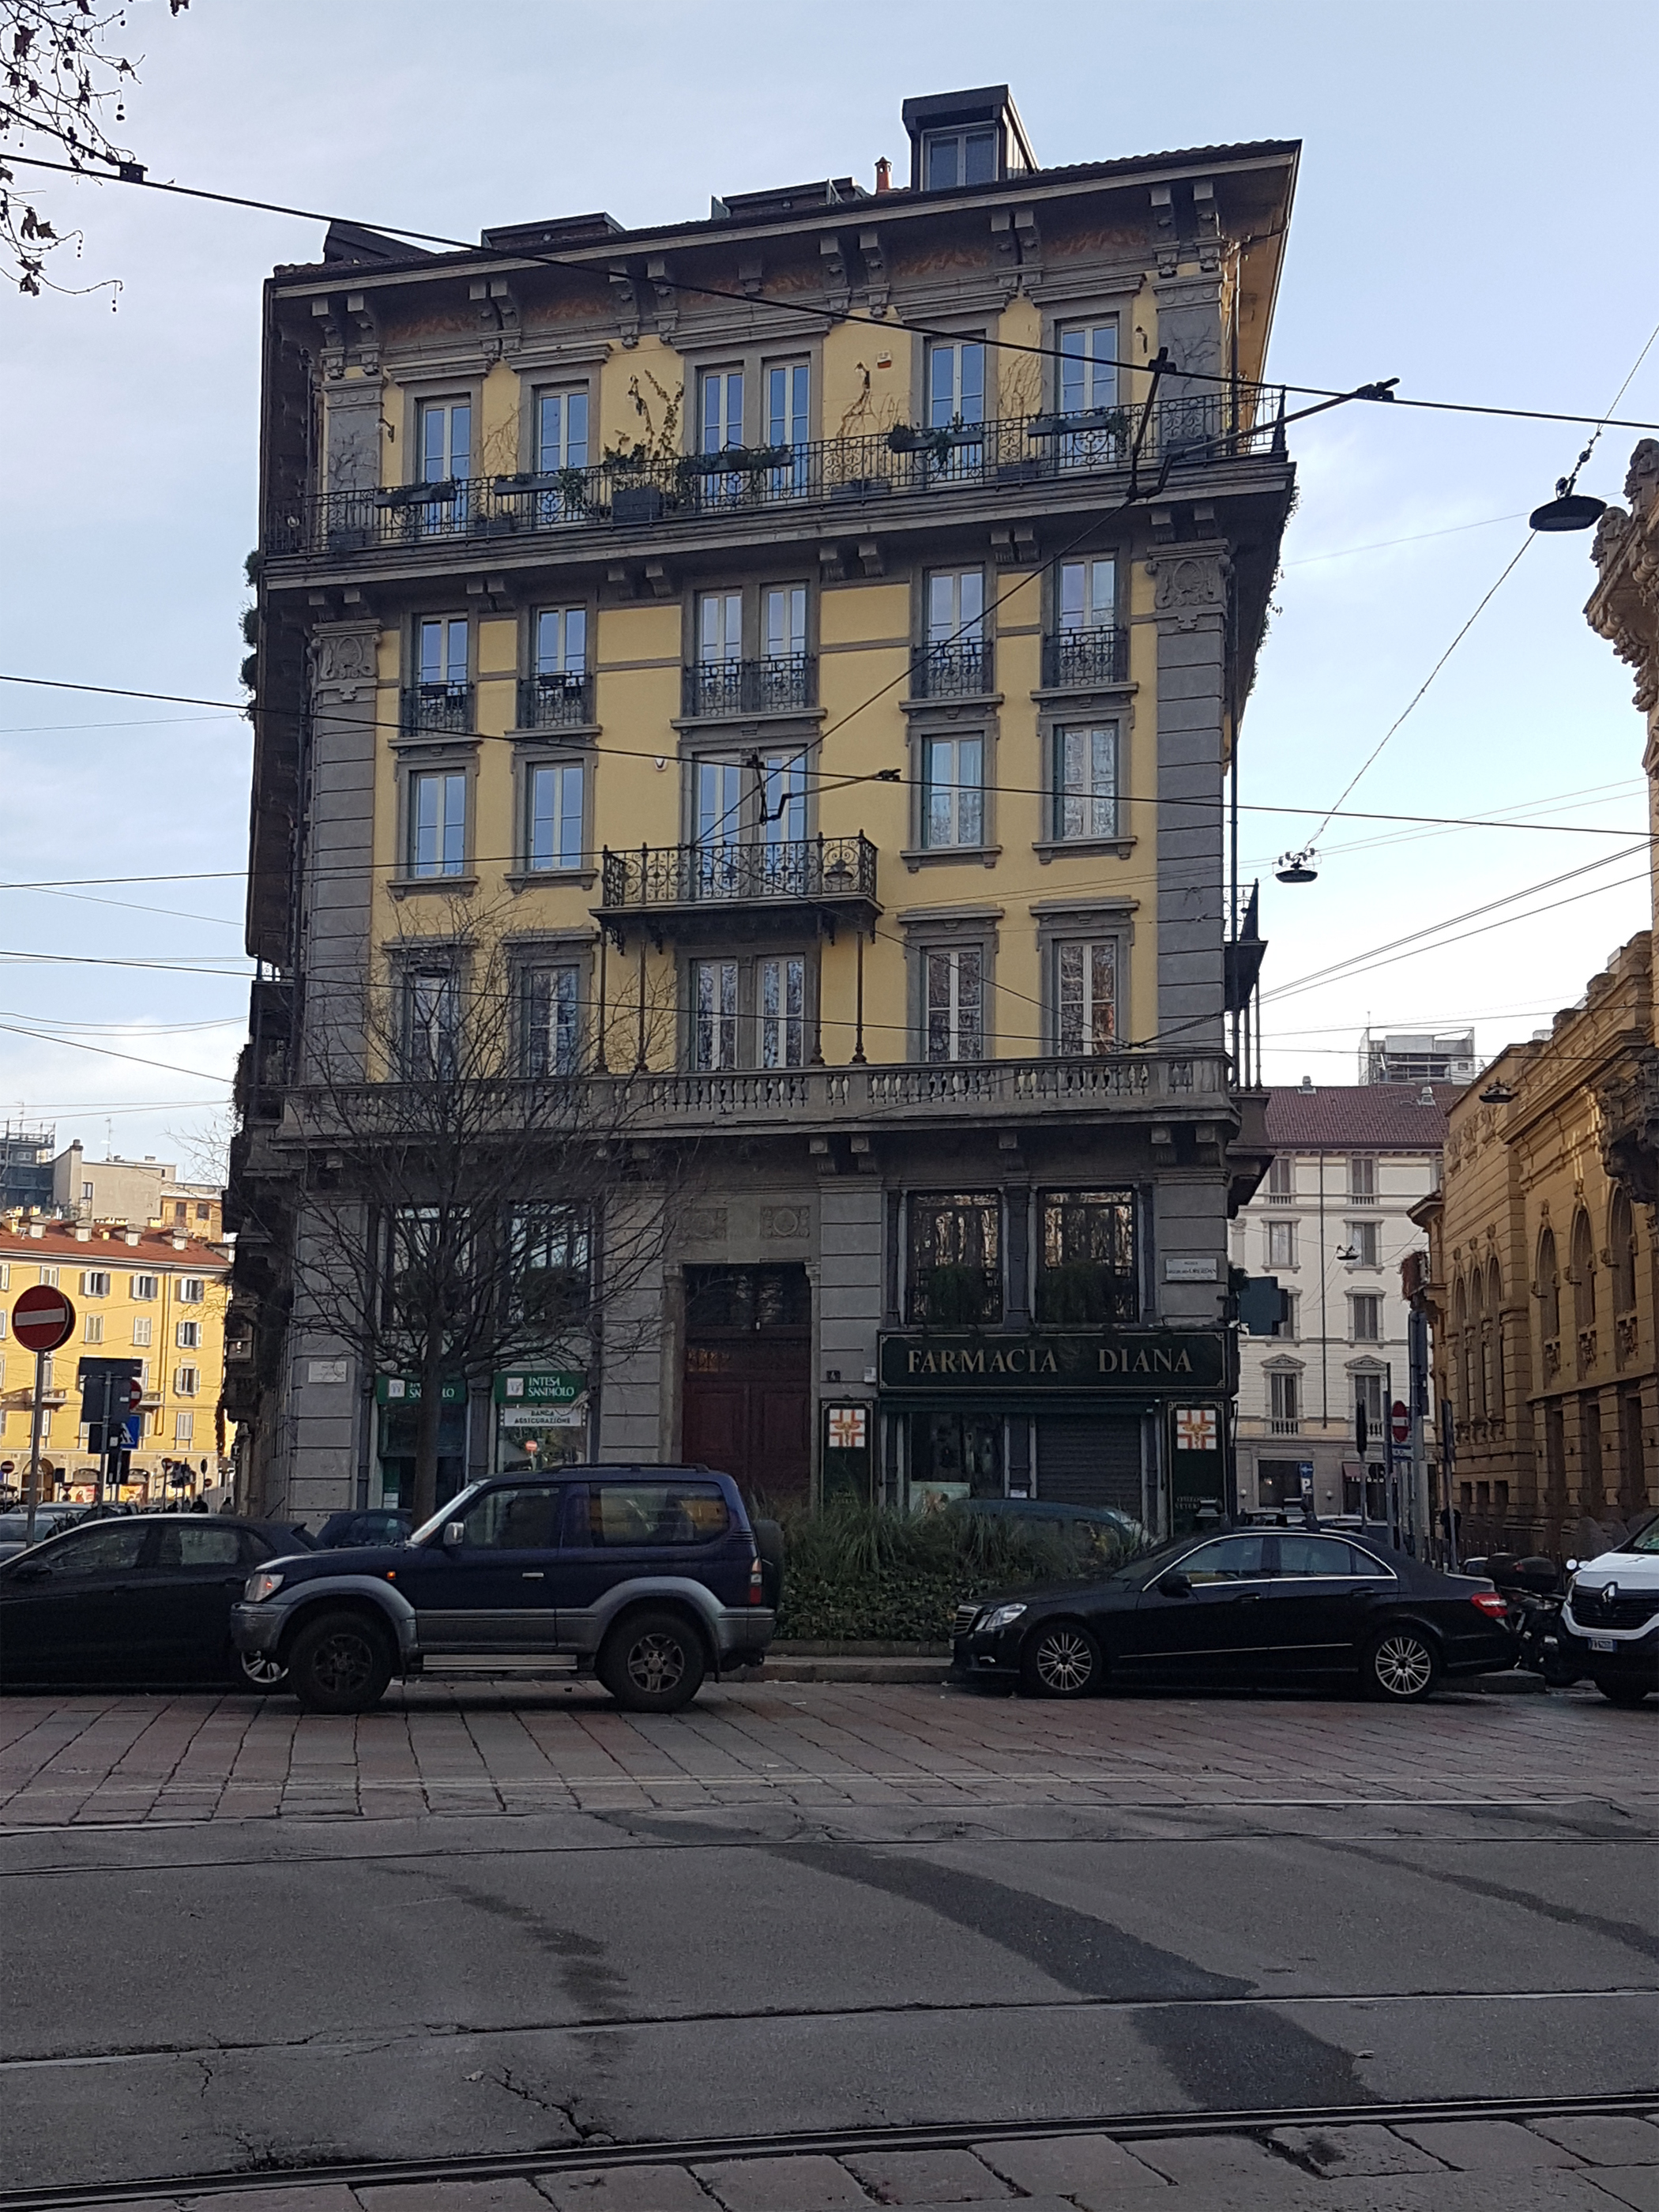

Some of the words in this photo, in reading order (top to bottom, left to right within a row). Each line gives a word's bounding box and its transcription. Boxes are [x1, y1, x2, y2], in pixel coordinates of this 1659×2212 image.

[908, 1349, 1058, 1373] FARMACIA
[1098, 1348, 1194, 1373] DIANA
[528, 1377, 560, 1386] INTESA
[528, 1386, 575, 1397] SANPAOLO
